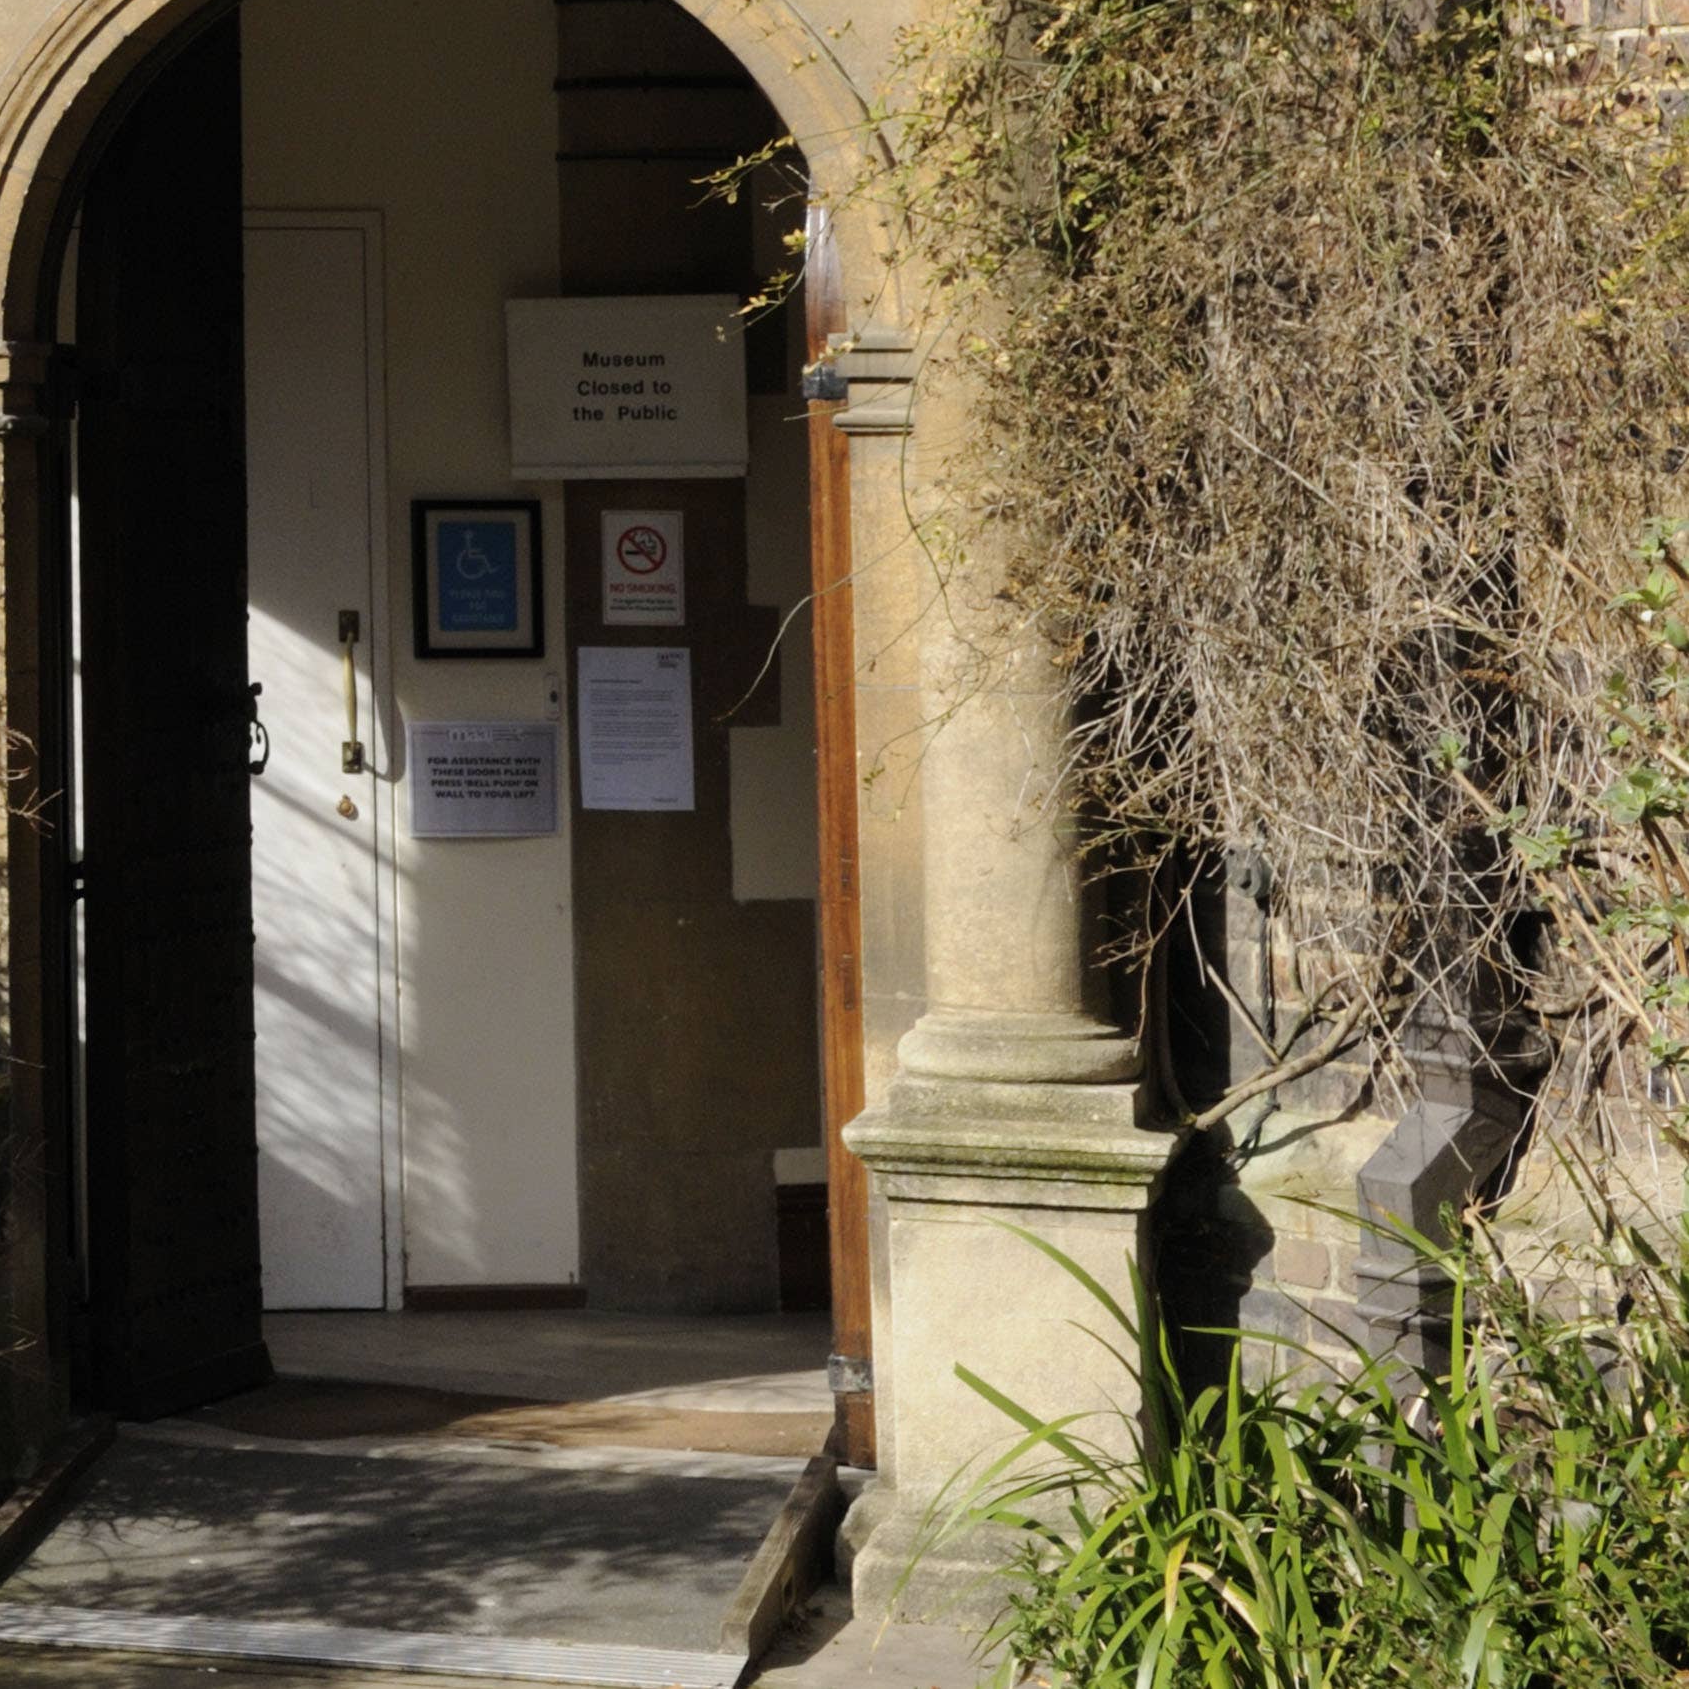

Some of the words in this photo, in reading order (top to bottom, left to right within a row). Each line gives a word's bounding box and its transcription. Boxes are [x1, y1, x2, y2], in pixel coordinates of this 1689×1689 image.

[583, 352, 665, 367] Museum
[577, 380, 644, 396] Closed
[653, 380, 671, 395] to
[573, 407, 604, 421] the
[618, 405, 677, 420] Public
[610, 582, 624, 593] NO
[427, 757, 448, 765] FOR
[451, 756, 511, 765] ASSISTANCE
[513, 756, 541, 765] WITH
[432, 768, 464, 776] THESE
[467, 768, 501, 776] DOORS
[504, 768, 537, 776] PLEASE
[431, 779, 462, 787] PRESS
[523, 779, 539, 787] ON
[435, 790, 465, 798] WALL
[468, 790, 482, 798] TO
[484, 790, 512, 798] YOUR
[513, 790, 535, 798] LEFT
